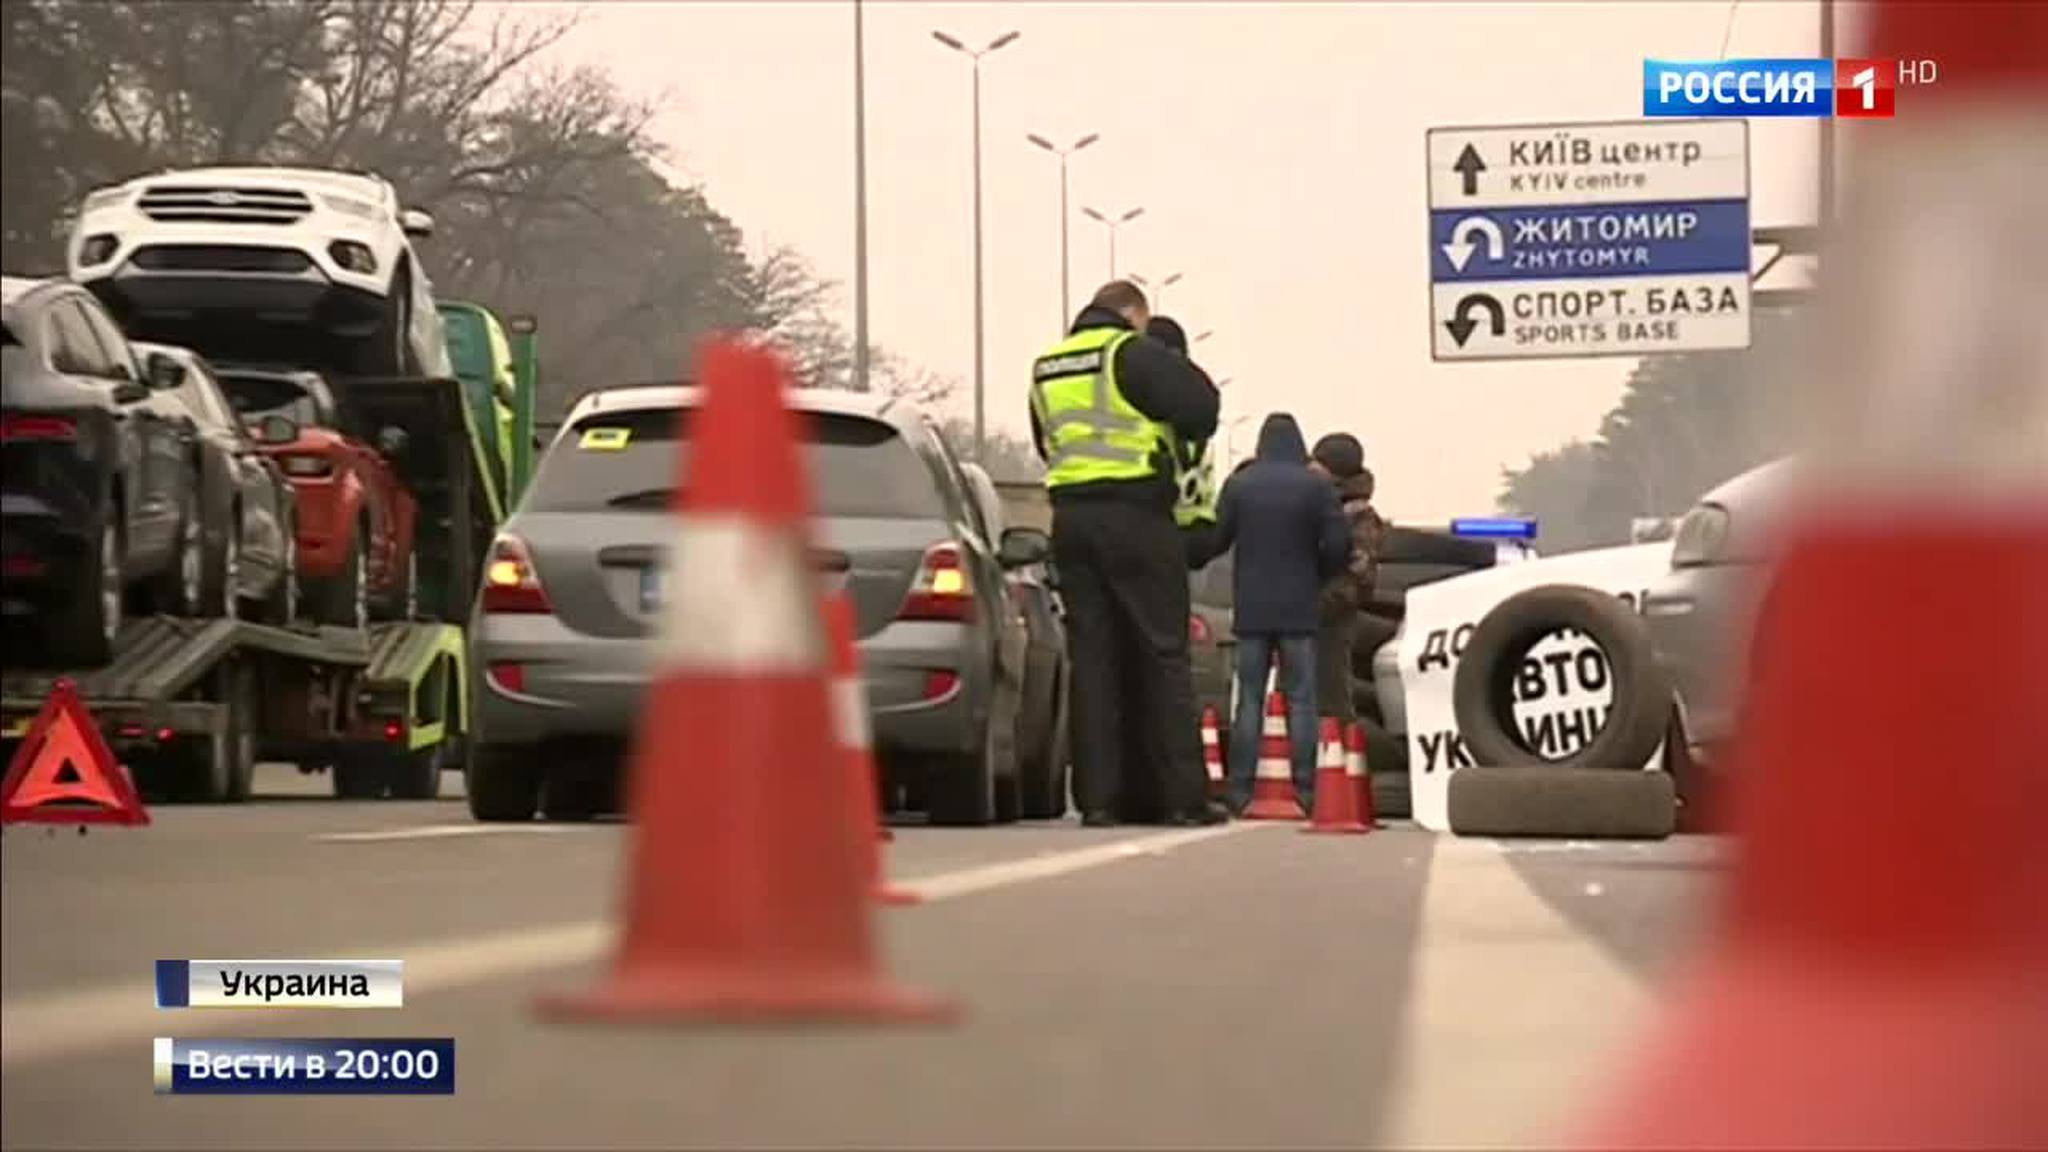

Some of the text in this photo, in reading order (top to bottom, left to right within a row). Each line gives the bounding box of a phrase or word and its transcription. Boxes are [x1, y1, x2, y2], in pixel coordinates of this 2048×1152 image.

[1508, 133, 1701, 166] КИЇВ центр
[1509, 172, 1647, 191] KYIV centre
[1513, 213, 1698, 244] ЖИТОМИР
[1513, 248, 1649, 270] ZHYTOMYR
[1513, 286, 1739, 318] СПОРТ. БАЗА
[1514, 322, 1679, 345] SPORTS BASE
